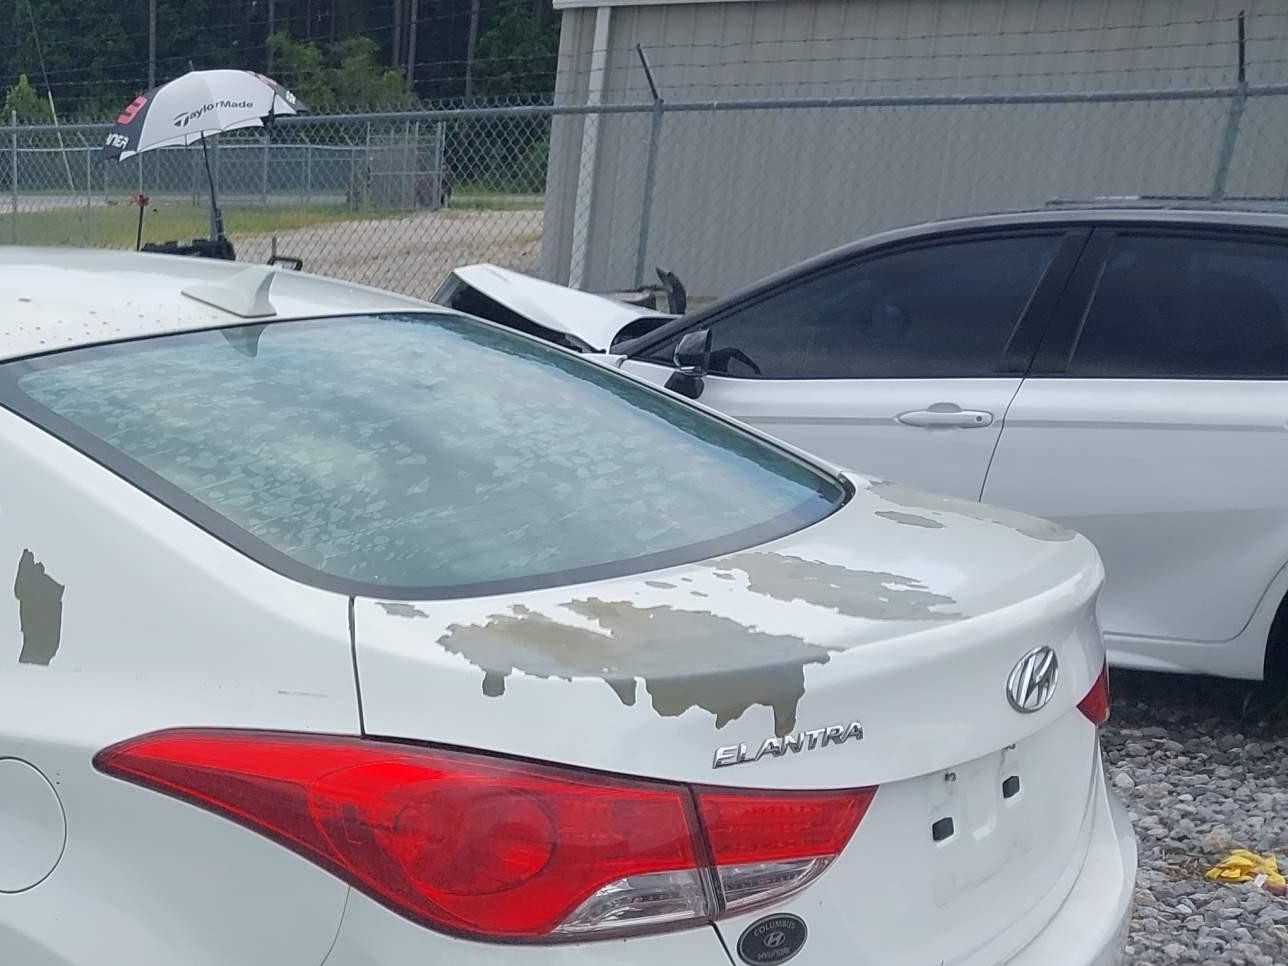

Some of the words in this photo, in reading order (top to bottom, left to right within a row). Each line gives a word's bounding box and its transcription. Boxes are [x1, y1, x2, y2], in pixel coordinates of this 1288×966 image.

[174, 100, 254, 127] TaylorMade
[712, 721, 864, 769] ELANTRA
[754, 920, 796, 937] COLUMBUS
